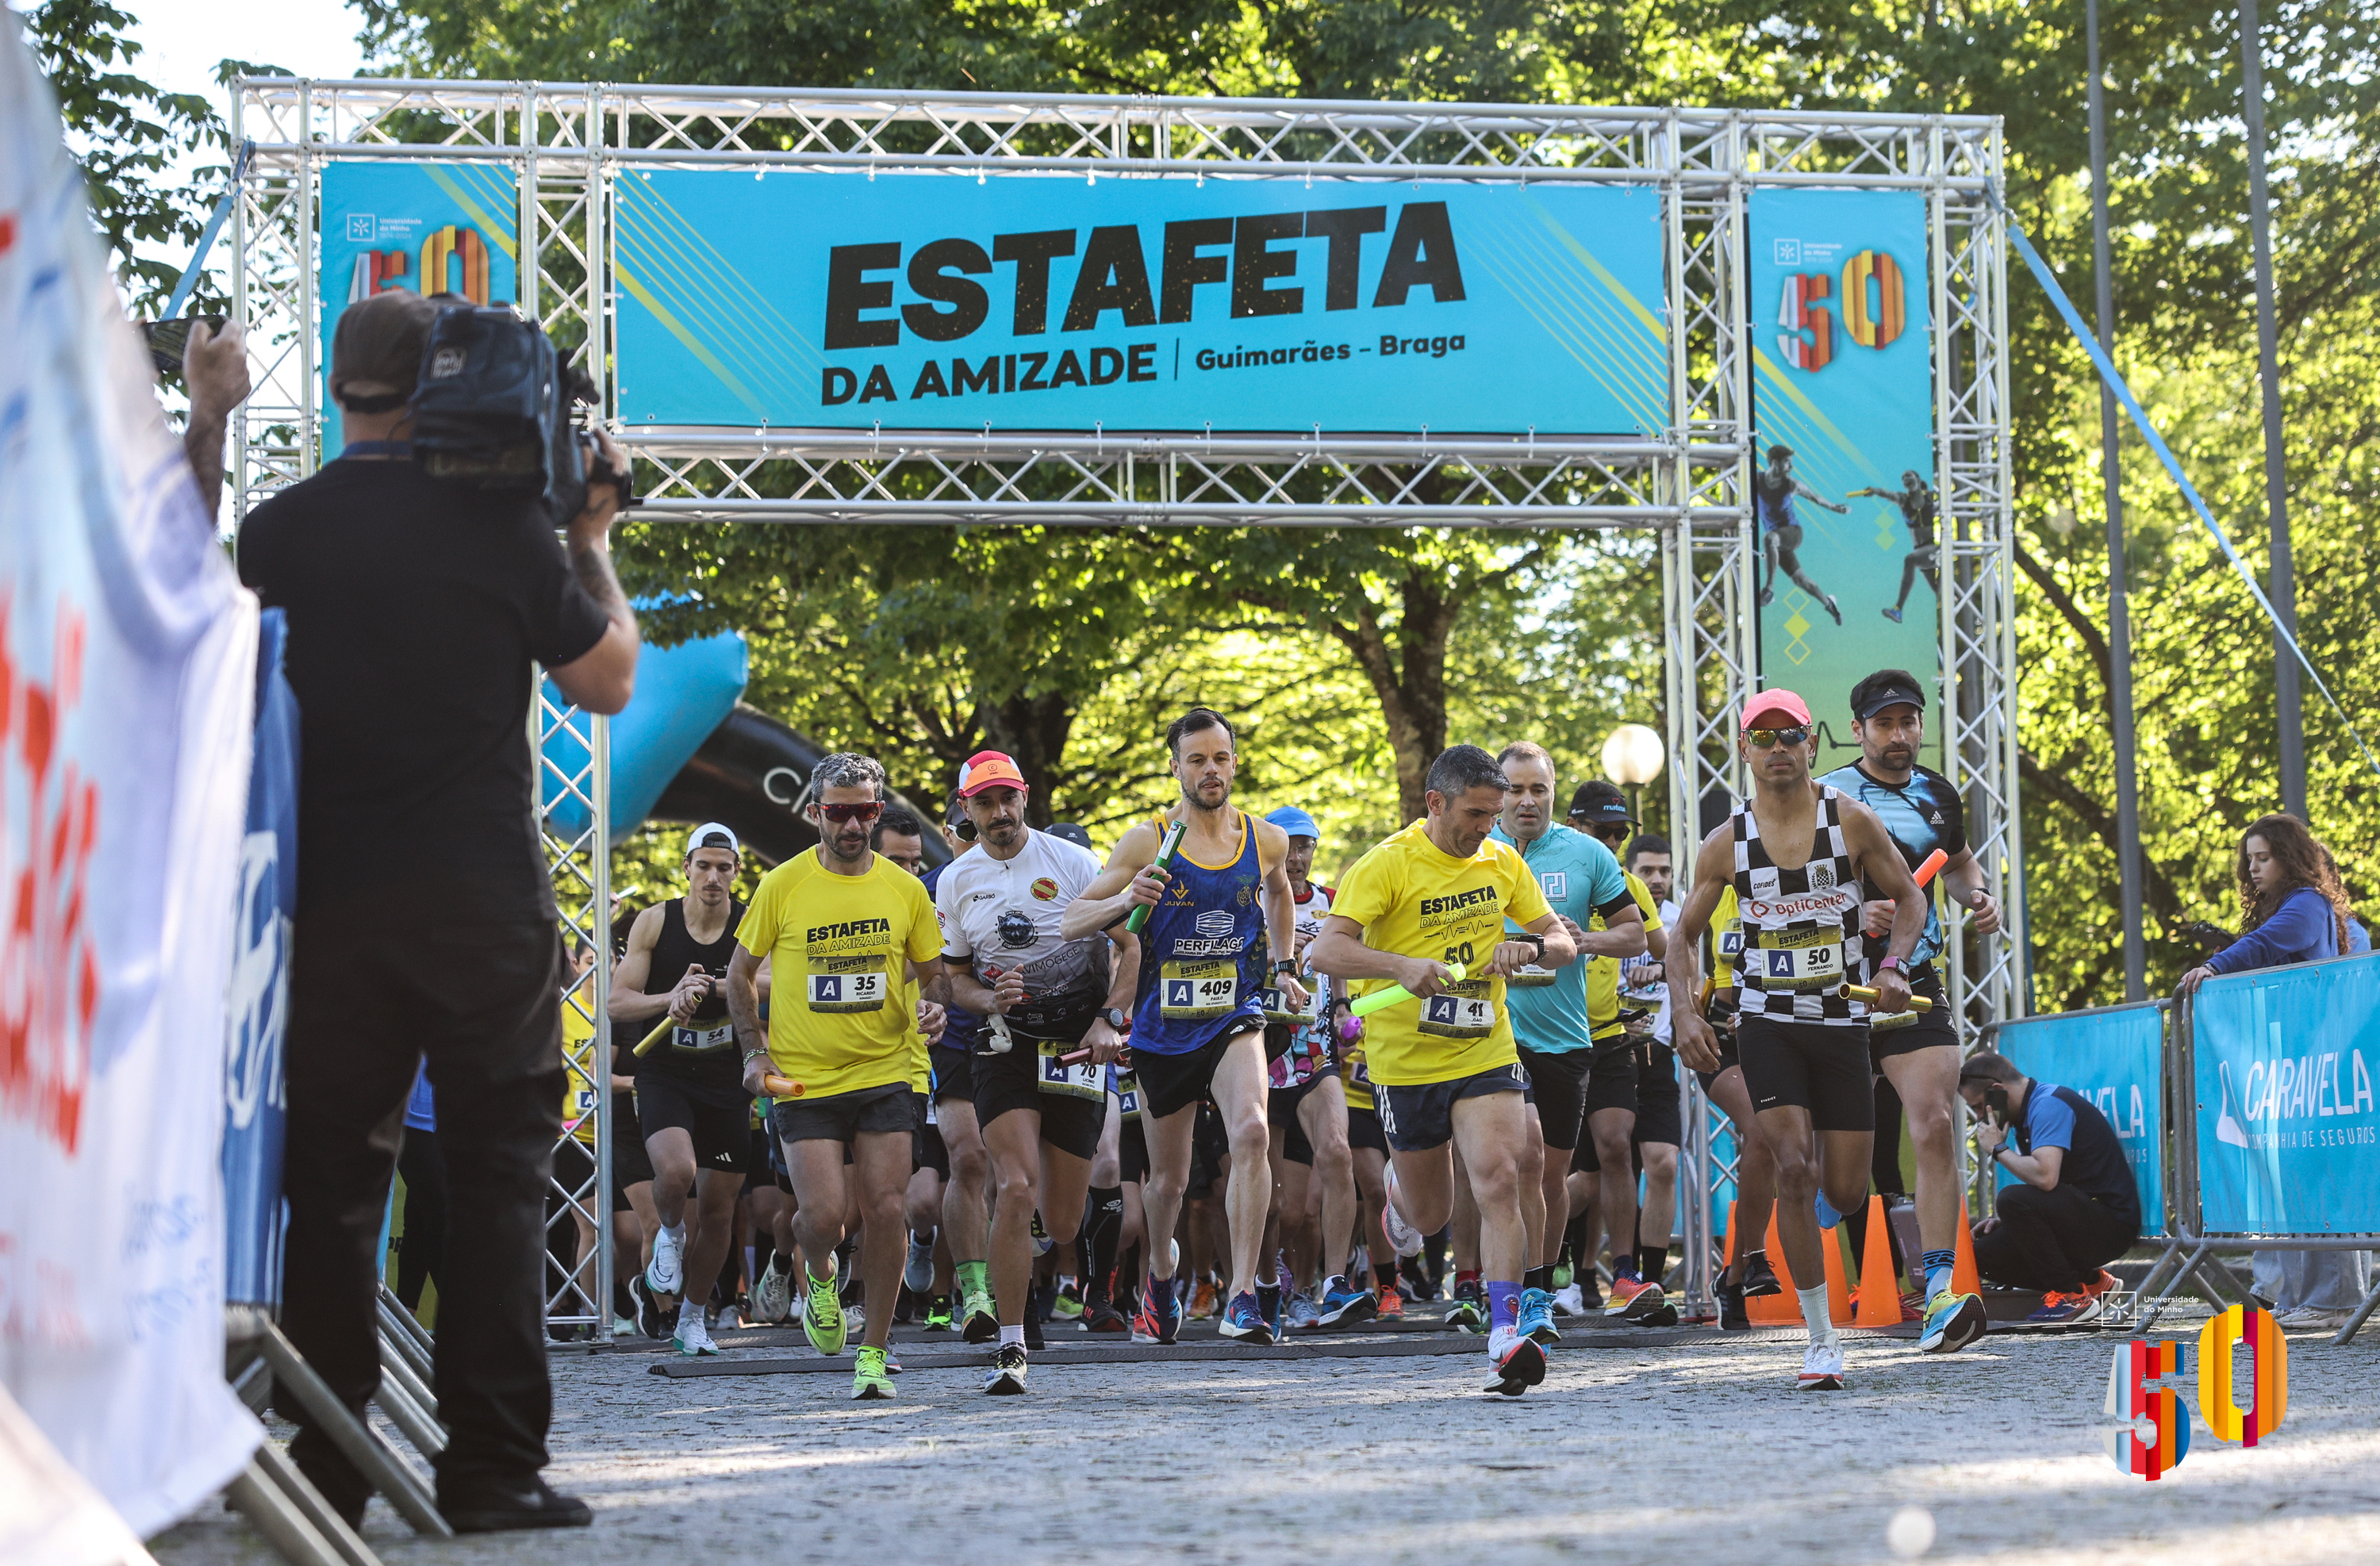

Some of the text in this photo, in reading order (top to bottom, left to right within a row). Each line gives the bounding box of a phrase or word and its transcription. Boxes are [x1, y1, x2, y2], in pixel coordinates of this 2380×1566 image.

[823, 200, 1467, 351] ESTAFETA
[1777, 250, 1906, 373] 50
[1196, 340, 1351, 371] Guimarães
[1380, 335, 1465, 359] Braga
[822, 343, 1157, 405] DA AMIZADE
[1753, 881, 1775, 889] COFIDES
[1421, 885, 1497, 915] ESTAFETA
[1775, 893, 1847, 916] OptiCenter
[1420, 902, 1499, 928] DA AMIZADE
[807, 919, 890, 943] ESTAFETA
[1779, 929, 1819, 945] ESTAFETA
[807, 934, 890, 955] DA AMIZADE
[1727, 937, 1737, 950] A
[828, 958, 867, 971] ESTAFETA
[1181, 961, 1219, 974] ESTAFETA
[1775, 948, 1830, 972] 50 A
[822, 981, 835, 996] A
[854, 976, 875, 990] 35
[1200, 981, 1232, 996] 409
[1174, 985, 1188, 1001] A
[1264, 993, 1275, 1007] A
[1435, 1001, 1450, 1019] A
[1468, 1002, 1484, 1016] 41
[682, 1033, 693, 1044] A
[708, 1028, 724, 1041] 54
[2244, 1048, 2374, 1122] CARAVELA
[1123, 1096, 1133, 1110] A
[2302, 1130, 2315, 1147] DE
[2320, 1127, 2375, 1146] SEGUROS
